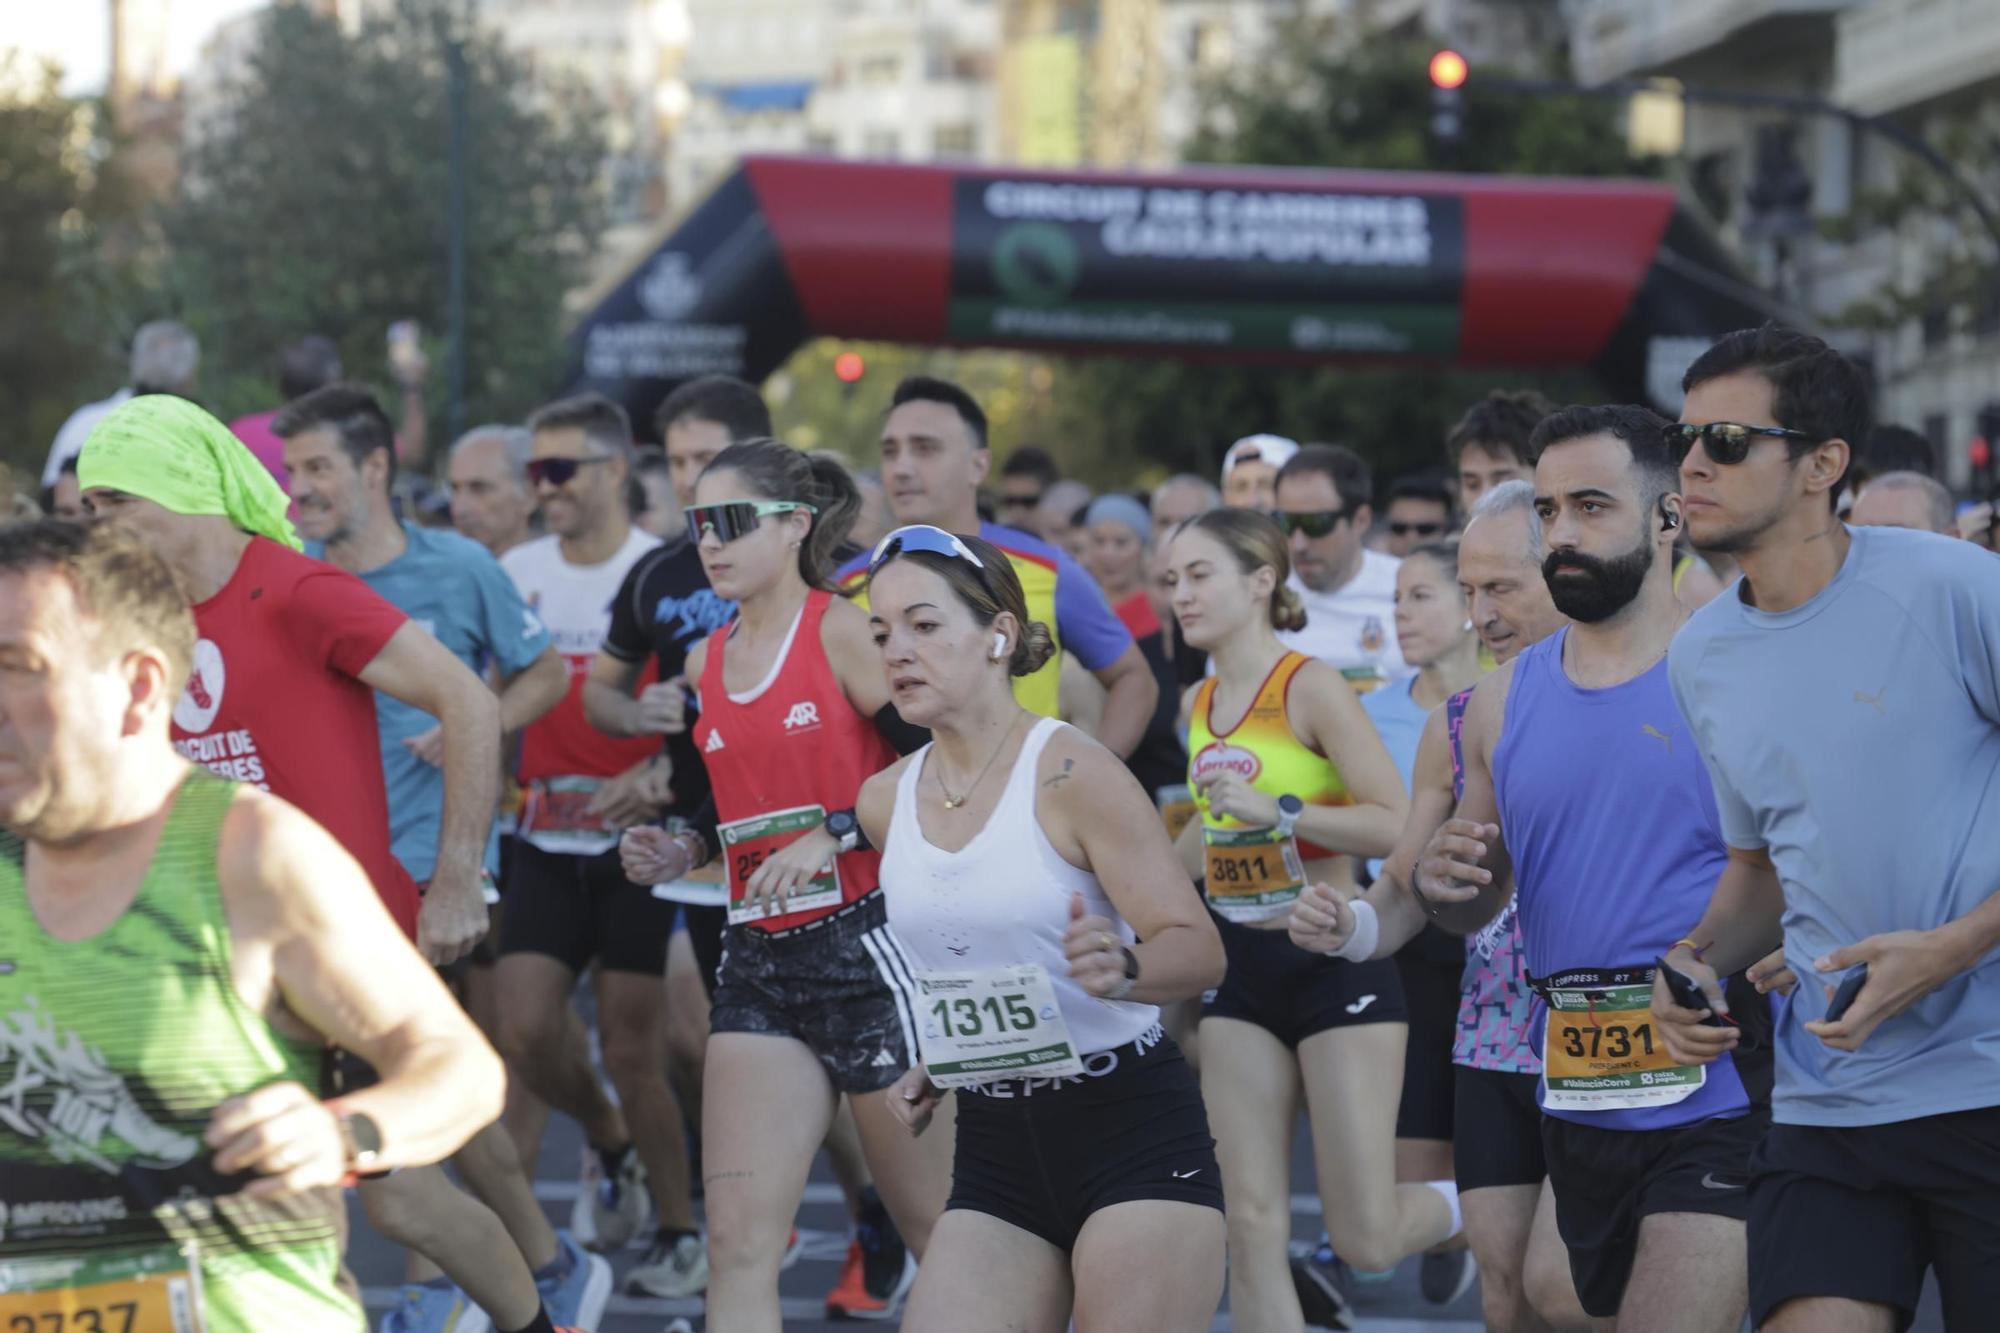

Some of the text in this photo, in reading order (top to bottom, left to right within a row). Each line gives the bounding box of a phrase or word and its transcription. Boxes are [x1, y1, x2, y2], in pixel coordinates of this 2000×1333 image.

[984, 181, 1143, 221] CIRCUIT
[1147, 188, 1203, 220] DE
[226, 729, 257, 756] DE
[1212, 855, 1269, 882] 3811
[932, 993, 1037, 1038] 1315
[1562, 1023, 1655, 1059] 3731
[1562, 1078, 1632, 1089] #ValènciaCorre
